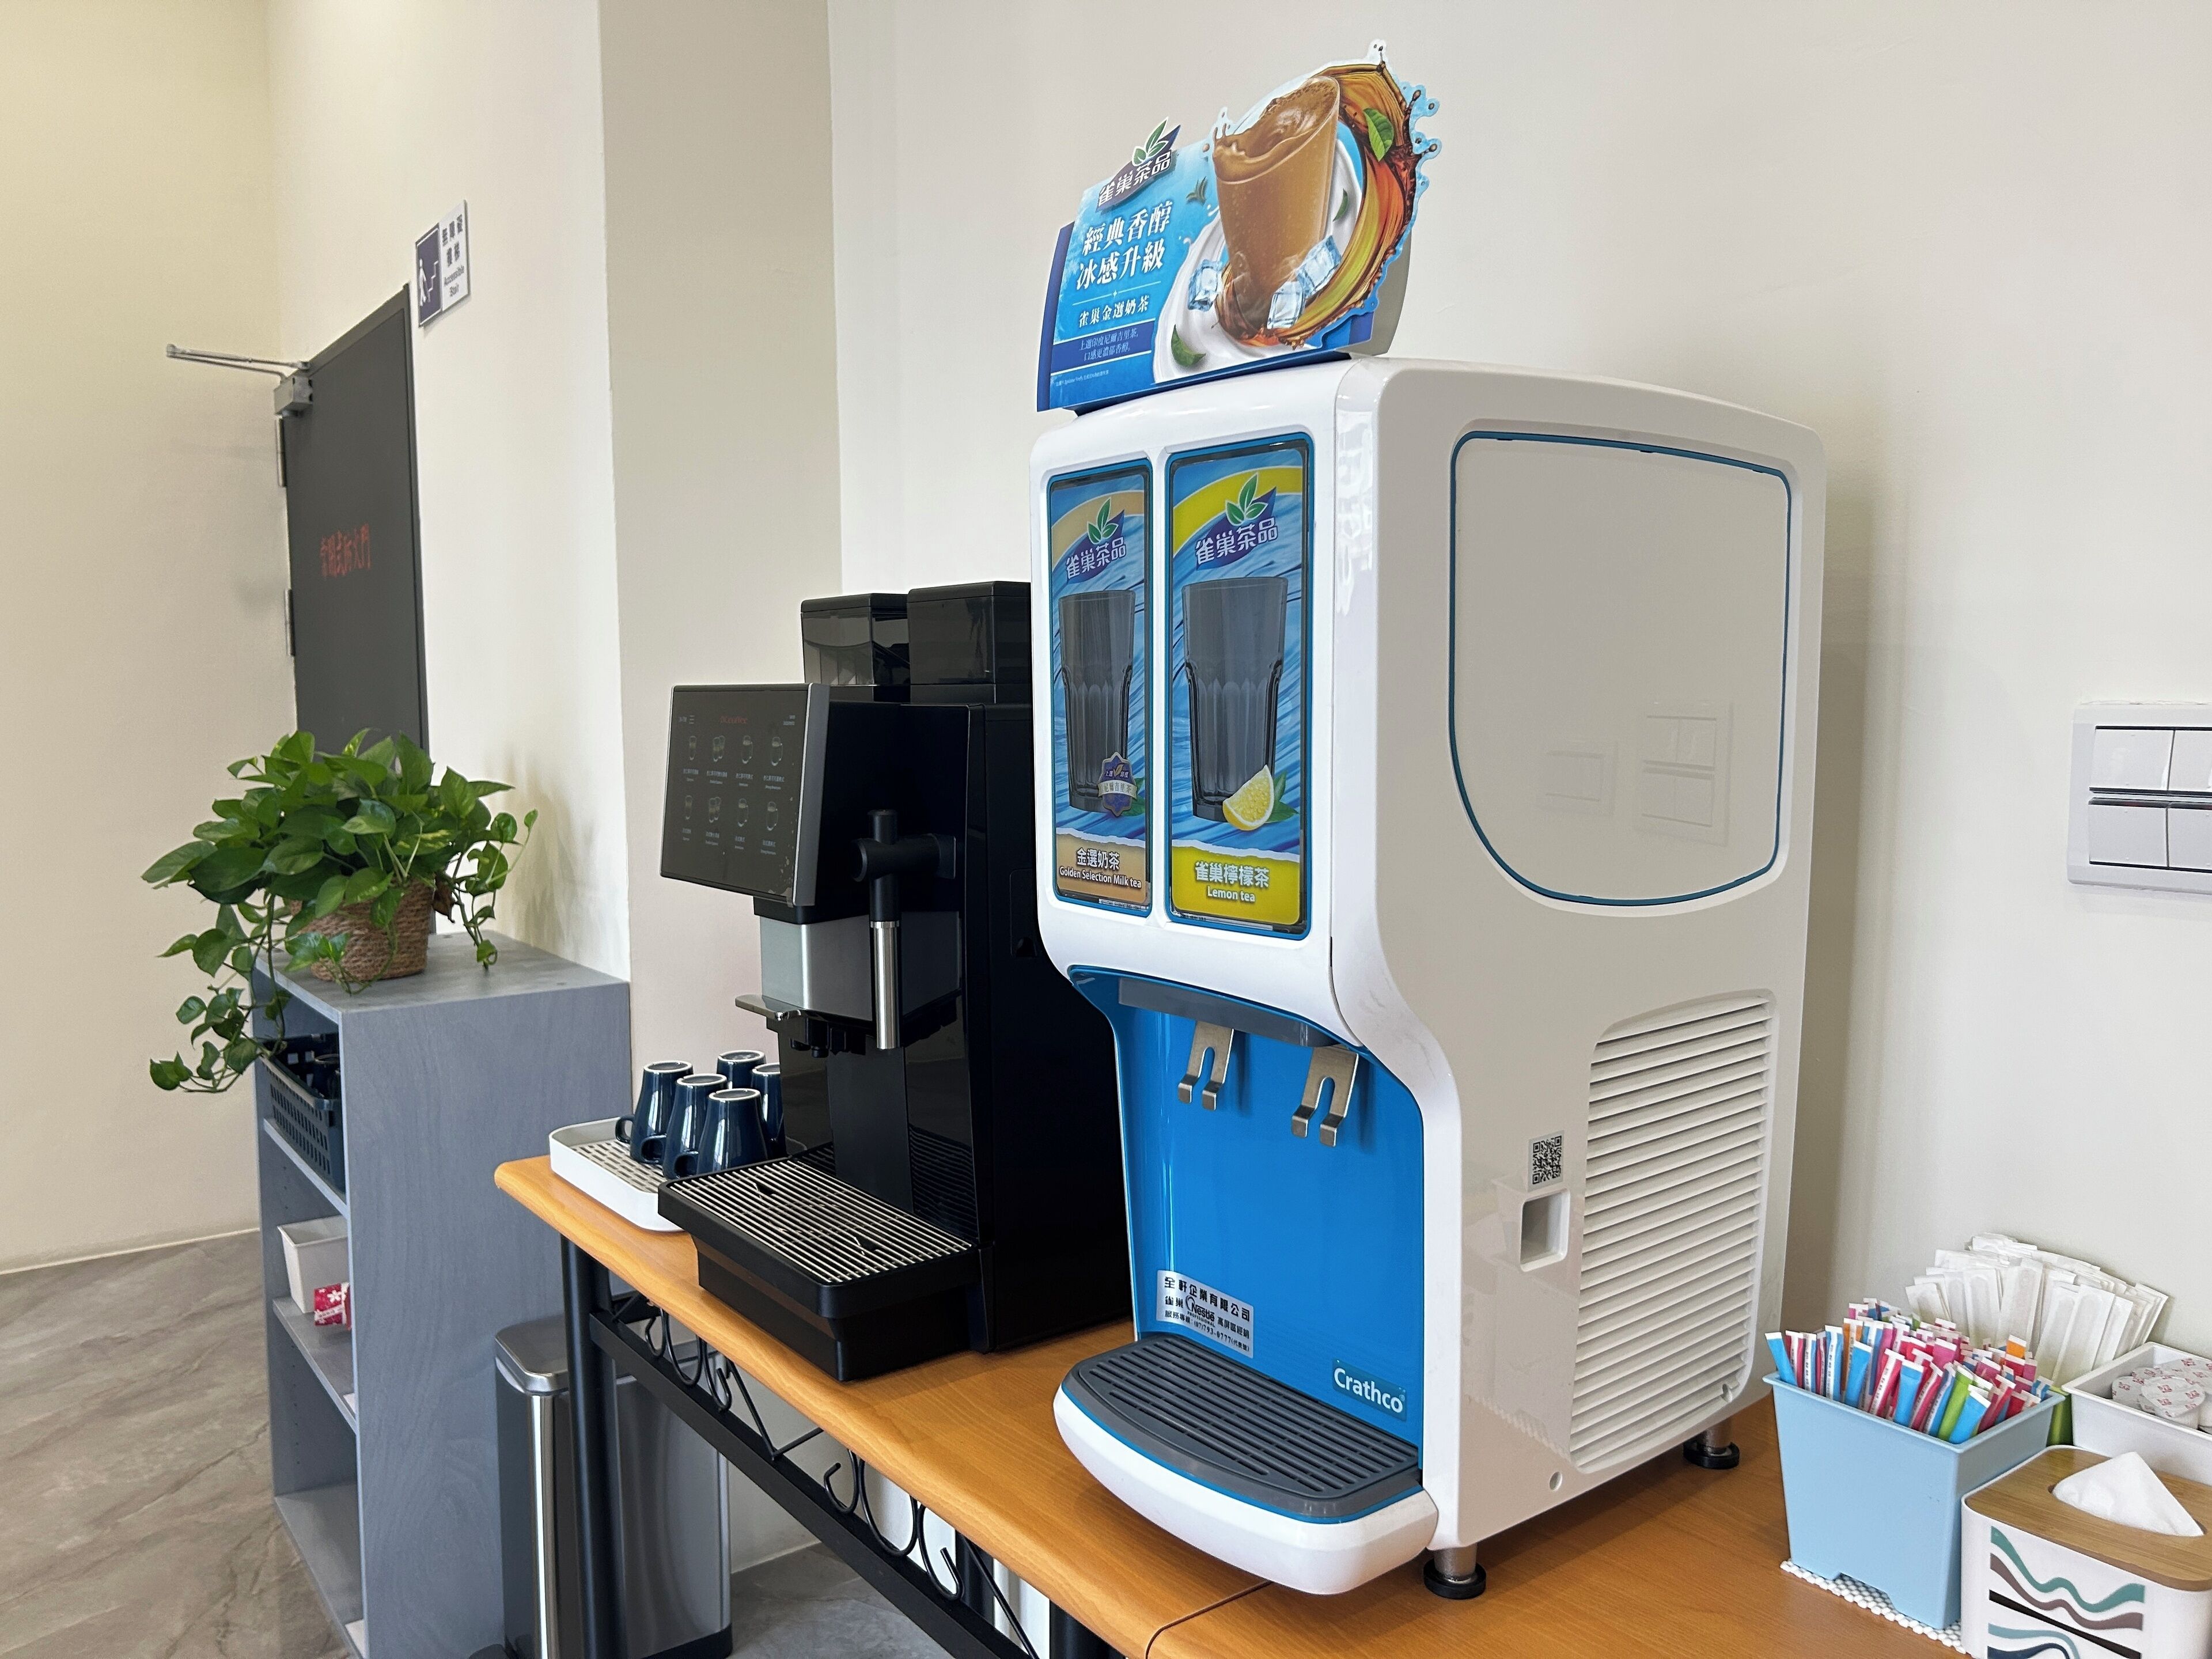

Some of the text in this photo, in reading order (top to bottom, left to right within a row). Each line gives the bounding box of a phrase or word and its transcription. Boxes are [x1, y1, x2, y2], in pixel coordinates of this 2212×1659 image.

[1099, 150, 1171, 206] 雀巢茶品
[1082, 200, 1173, 256] 經典香醇
[1076, 238, 1165, 290] 冰感升級
[1079, 295, 1149, 328] 雀巢金選奶茶
[1195, 517, 1278, 565] 雀巢茶品
[1066, 537, 1126, 579] 雀巢茶品
[1077, 847, 1120, 870] 金選奶茶
[1195, 861, 1269, 888] 雀巢檸檬茶
[1059, 866, 1142, 888] Golden Selection Milk tea
[1207, 886, 1255, 902] Lemon tea
[1165, 1296, 1184, 1309] 雀巢
